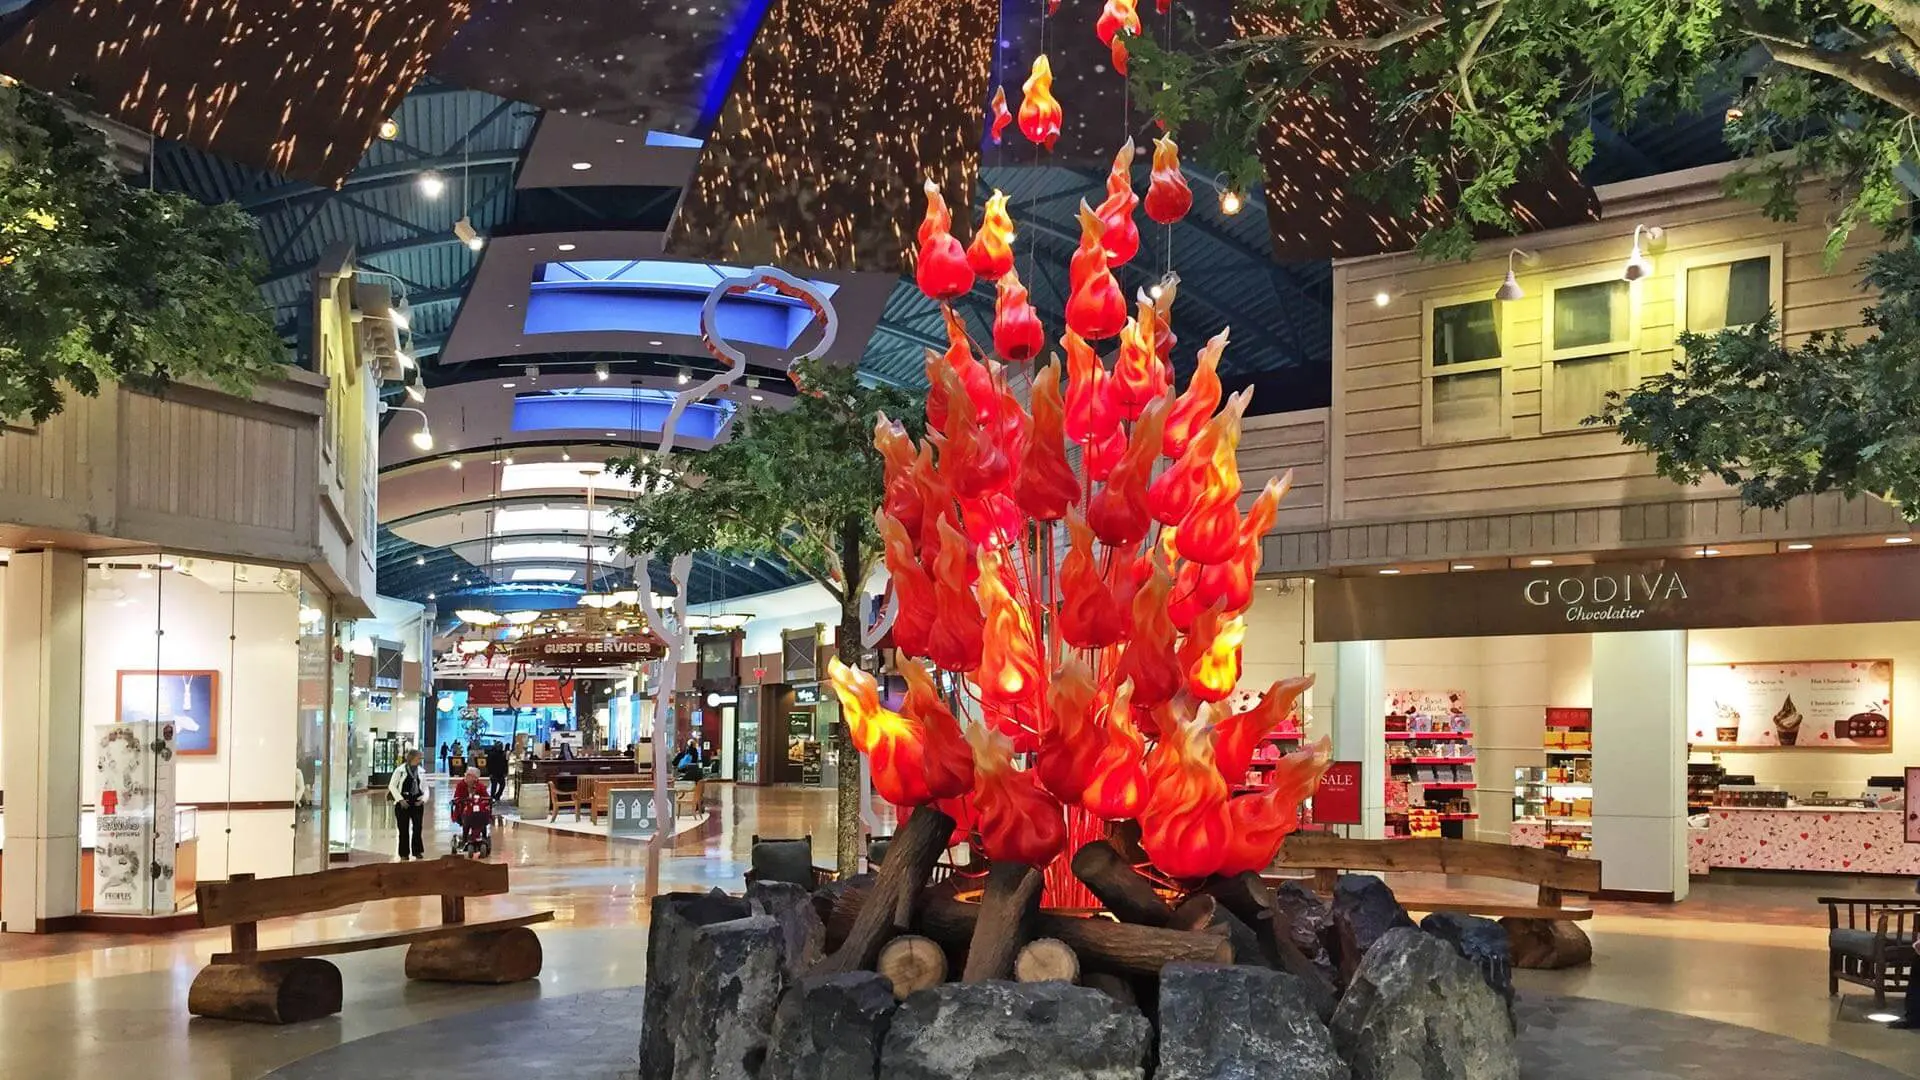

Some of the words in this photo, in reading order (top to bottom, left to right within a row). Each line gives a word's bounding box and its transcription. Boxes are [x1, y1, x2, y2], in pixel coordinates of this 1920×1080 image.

[1524, 571, 1689, 606] GODIVA
[1565, 605, 1645, 622] Chocolatier
[544, 643, 582, 655] GUEST
[585, 642, 651, 654] SERVICES
[1320, 774, 1353, 786] SALE
